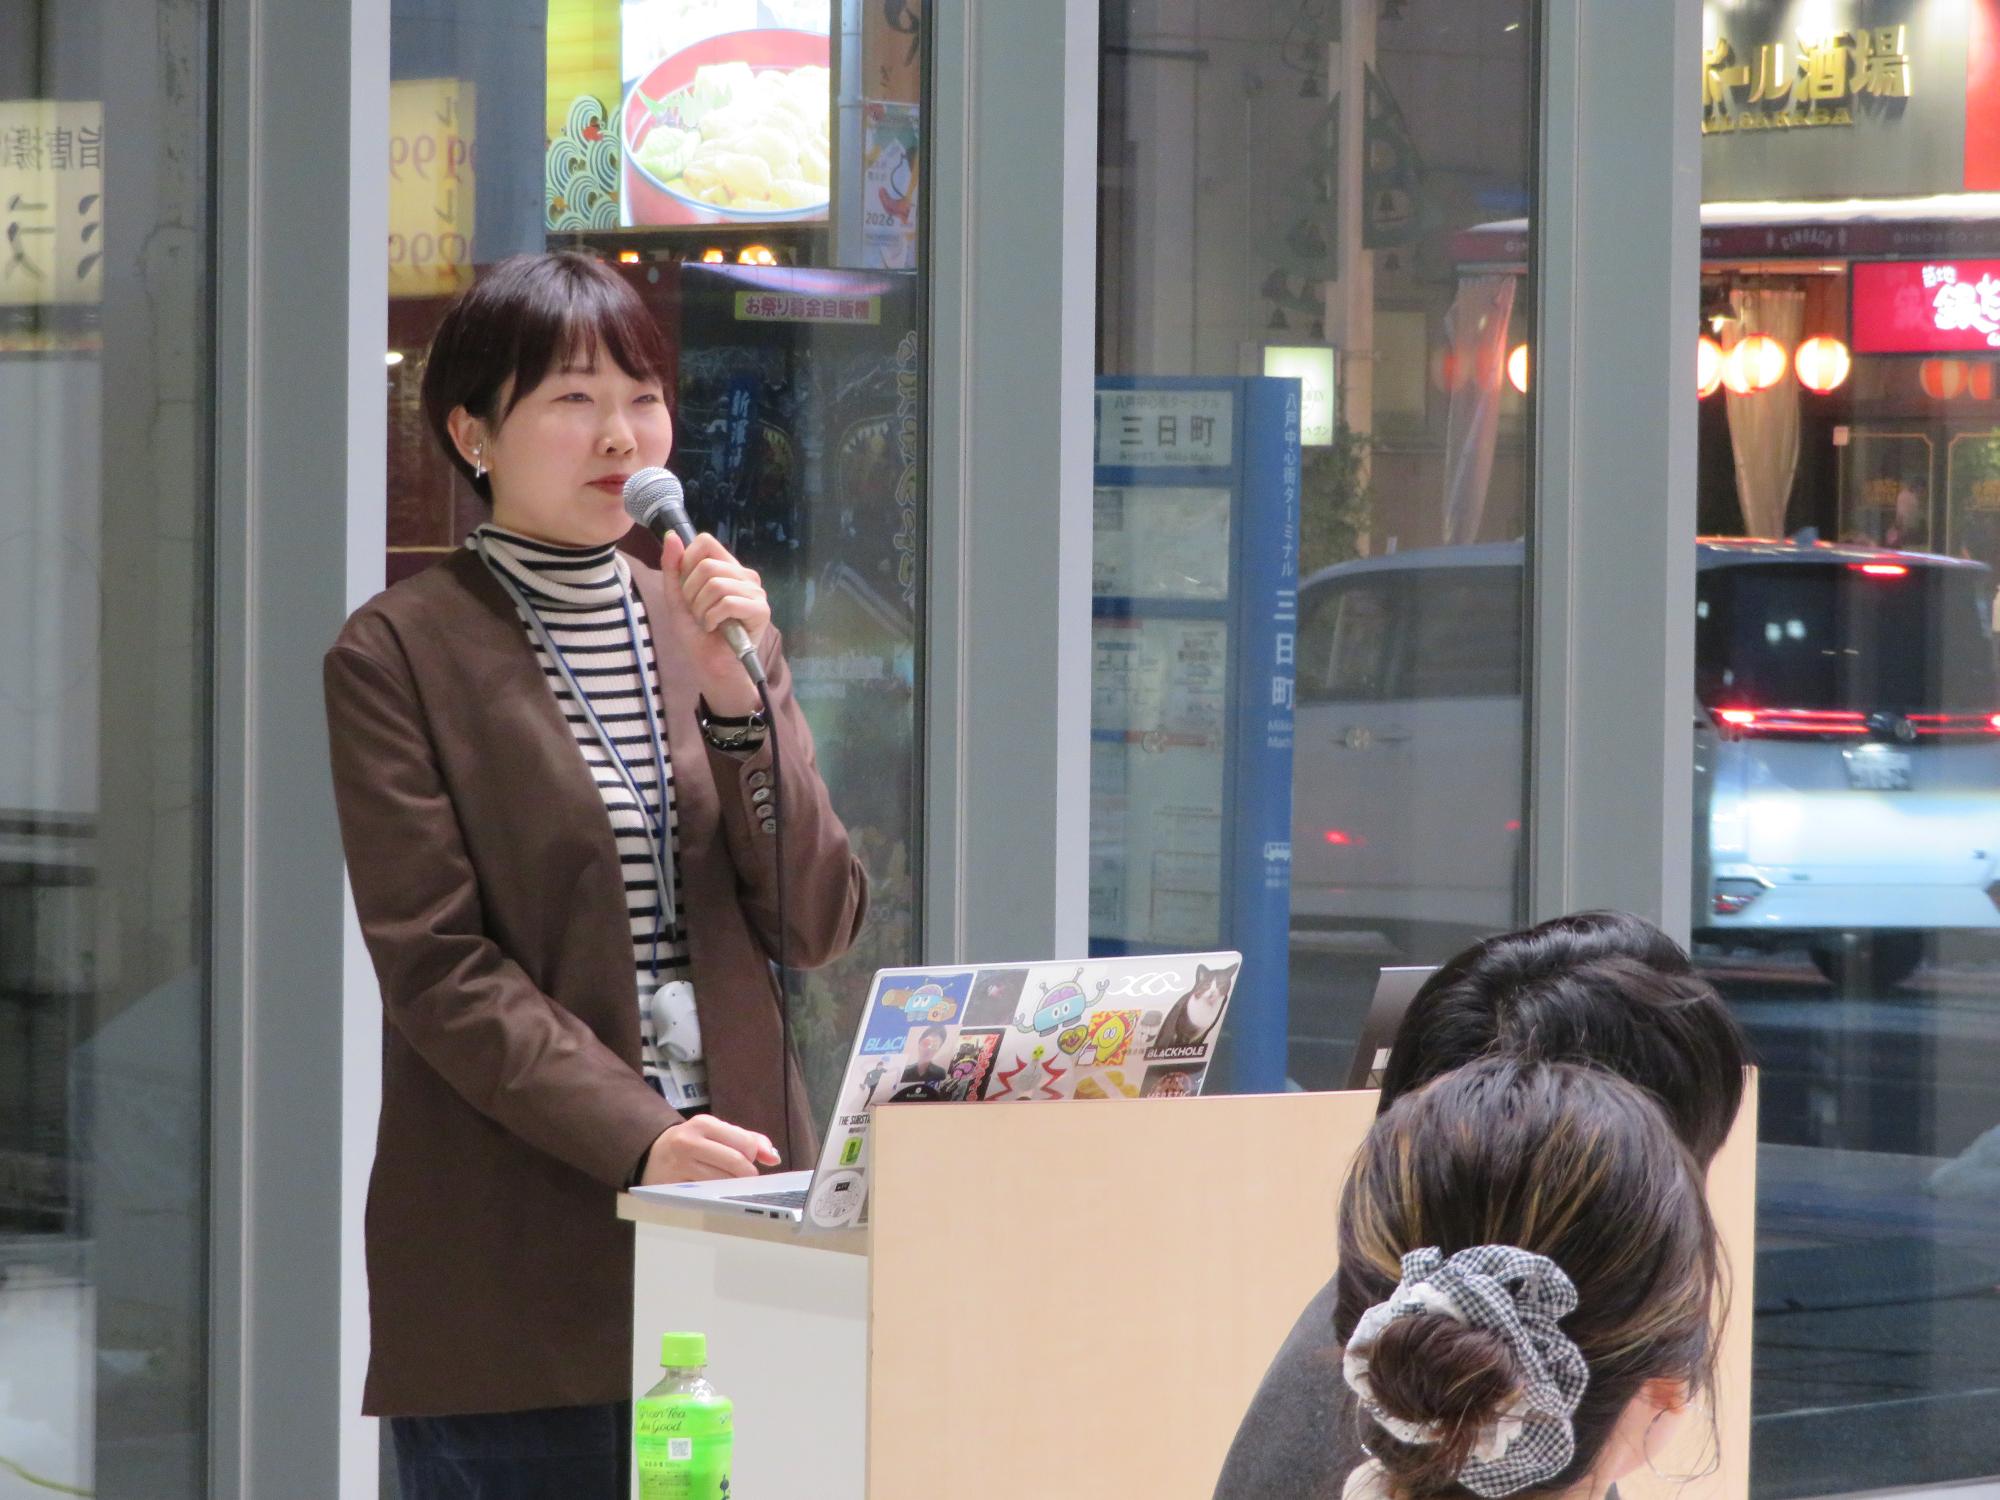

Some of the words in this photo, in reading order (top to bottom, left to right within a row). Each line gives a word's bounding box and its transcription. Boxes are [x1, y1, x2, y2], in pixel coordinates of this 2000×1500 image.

[1119, 415, 1216, 447] 三日町
[1271, 590, 1296, 709] 三日町
[1146, 1045, 1205, 1058] BLACKHOLE
